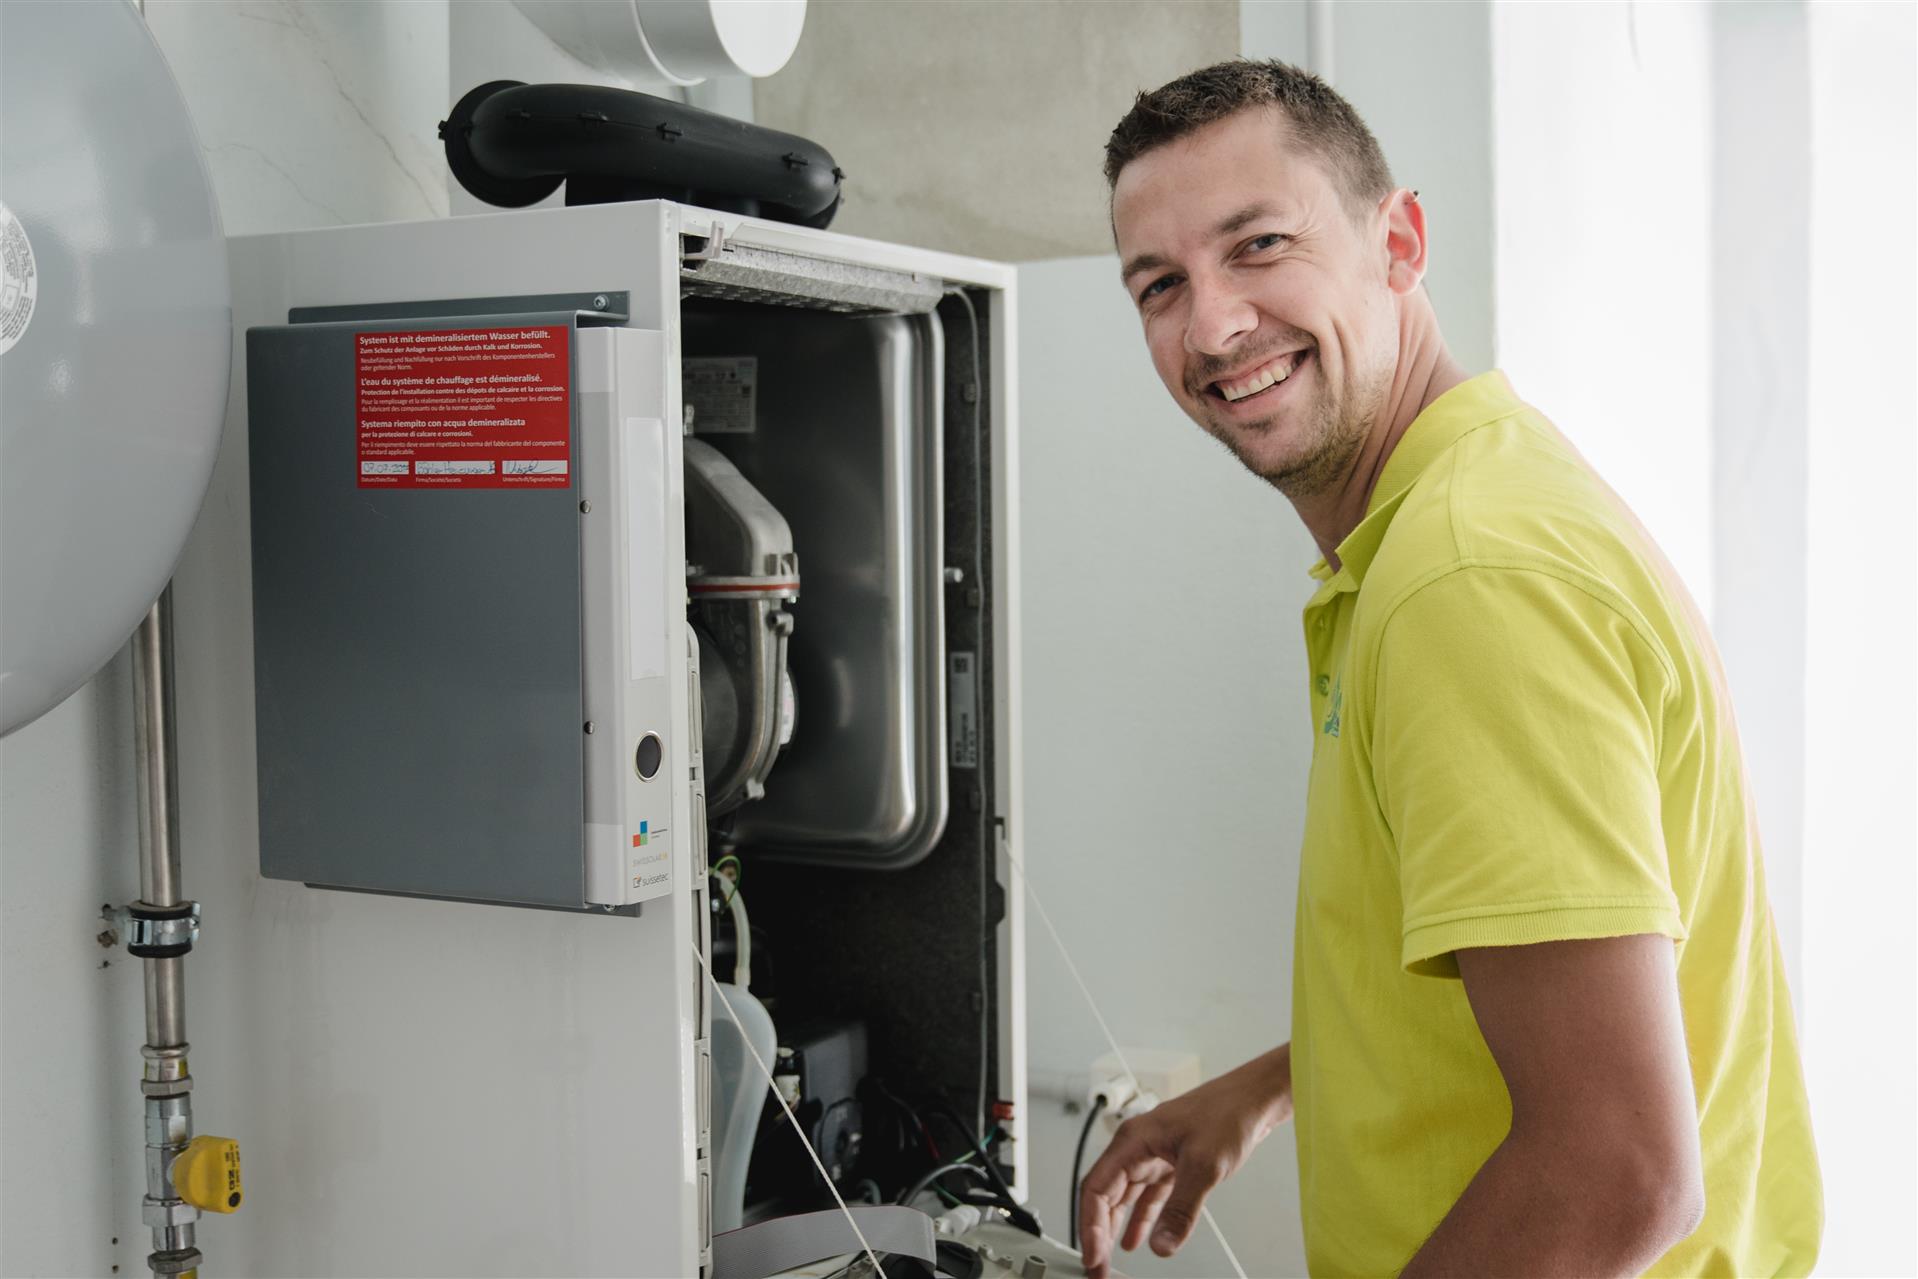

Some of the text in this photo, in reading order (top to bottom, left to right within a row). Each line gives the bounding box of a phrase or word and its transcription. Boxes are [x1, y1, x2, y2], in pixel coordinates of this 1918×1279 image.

[360, 336, 387, 346] System
[400, 335, 414, 343] mit
[415, 333, 488, 342] demineralisiertem
[489, 332, 519, 340] Wasser
[520, 331, 550, 339] befüllt.
[405, 346, 426, 354] Anlage
[361, 378, 380, 386] L'eau
[393, 377, 424, 387] système
[436, 376, 474, 386] chauffage
[475, 375, 488, 383] est
[489, 374, 542, 383] démineralisé.
[361, 420, 392, 429] Systema
[393, 420, 426, 429] riempito
[467, 418, 526, 426] demineralizata
